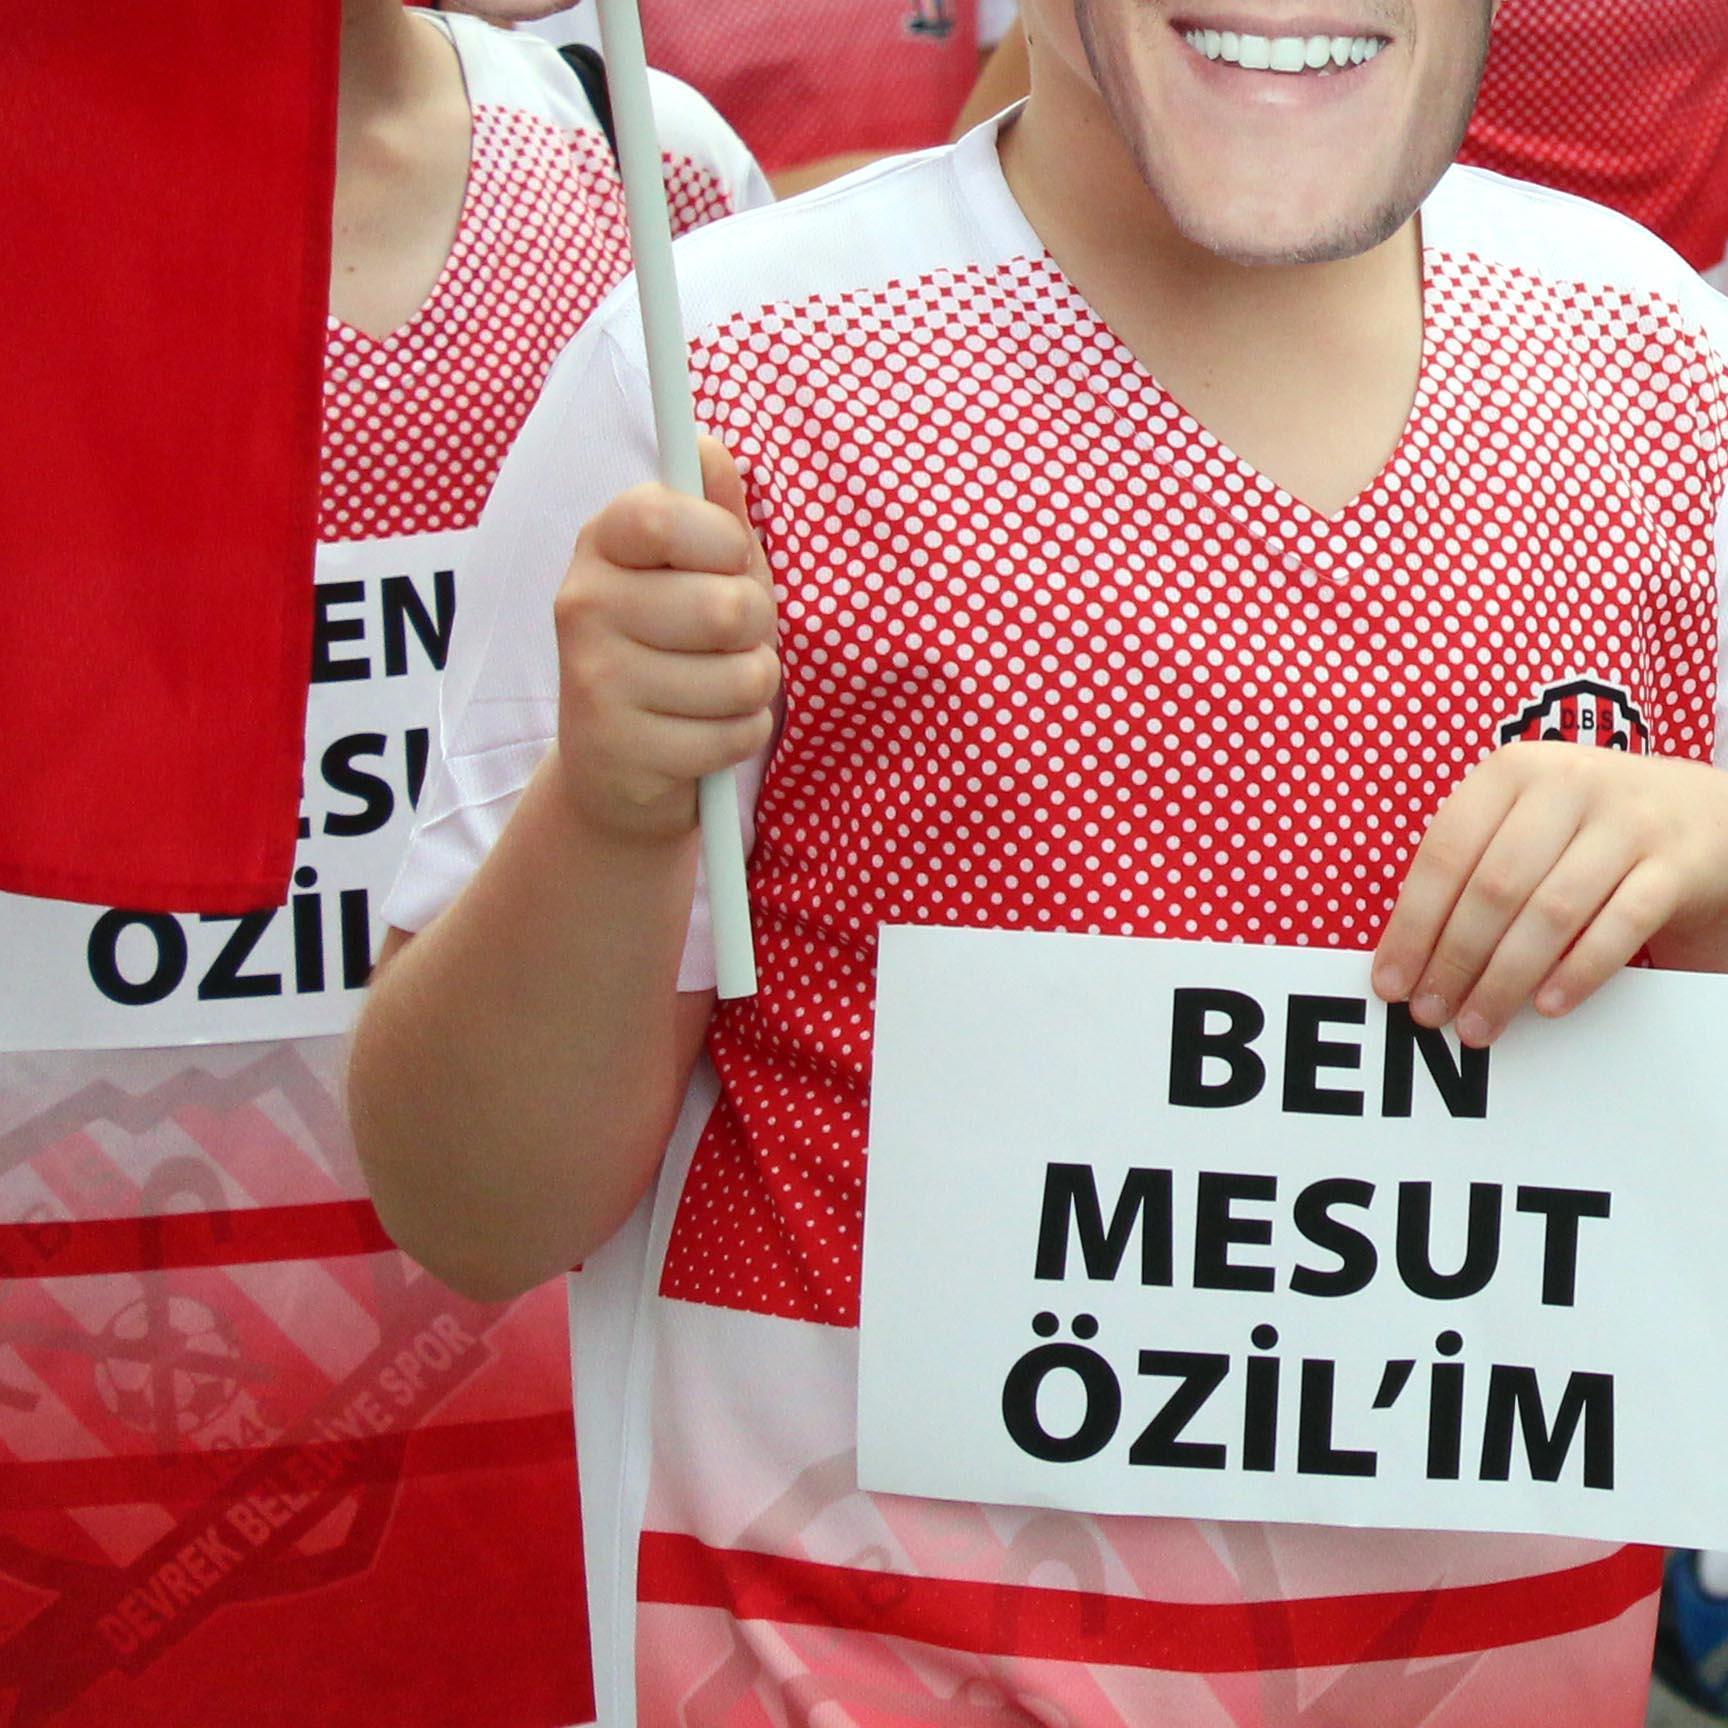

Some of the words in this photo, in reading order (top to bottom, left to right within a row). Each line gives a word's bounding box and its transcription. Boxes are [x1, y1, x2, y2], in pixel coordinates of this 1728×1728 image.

[312, 569, 456, 685] EN
[1166, 986, 1492, 1120] BEN
[1032, 1161, 1612, 1309] MESUT
[1000, 1310, 1617, 1492] ÖZİL'İM
[100, 1529, 246, 1654] DEVREK
[379, 1312, 479, 1408] SPOR
